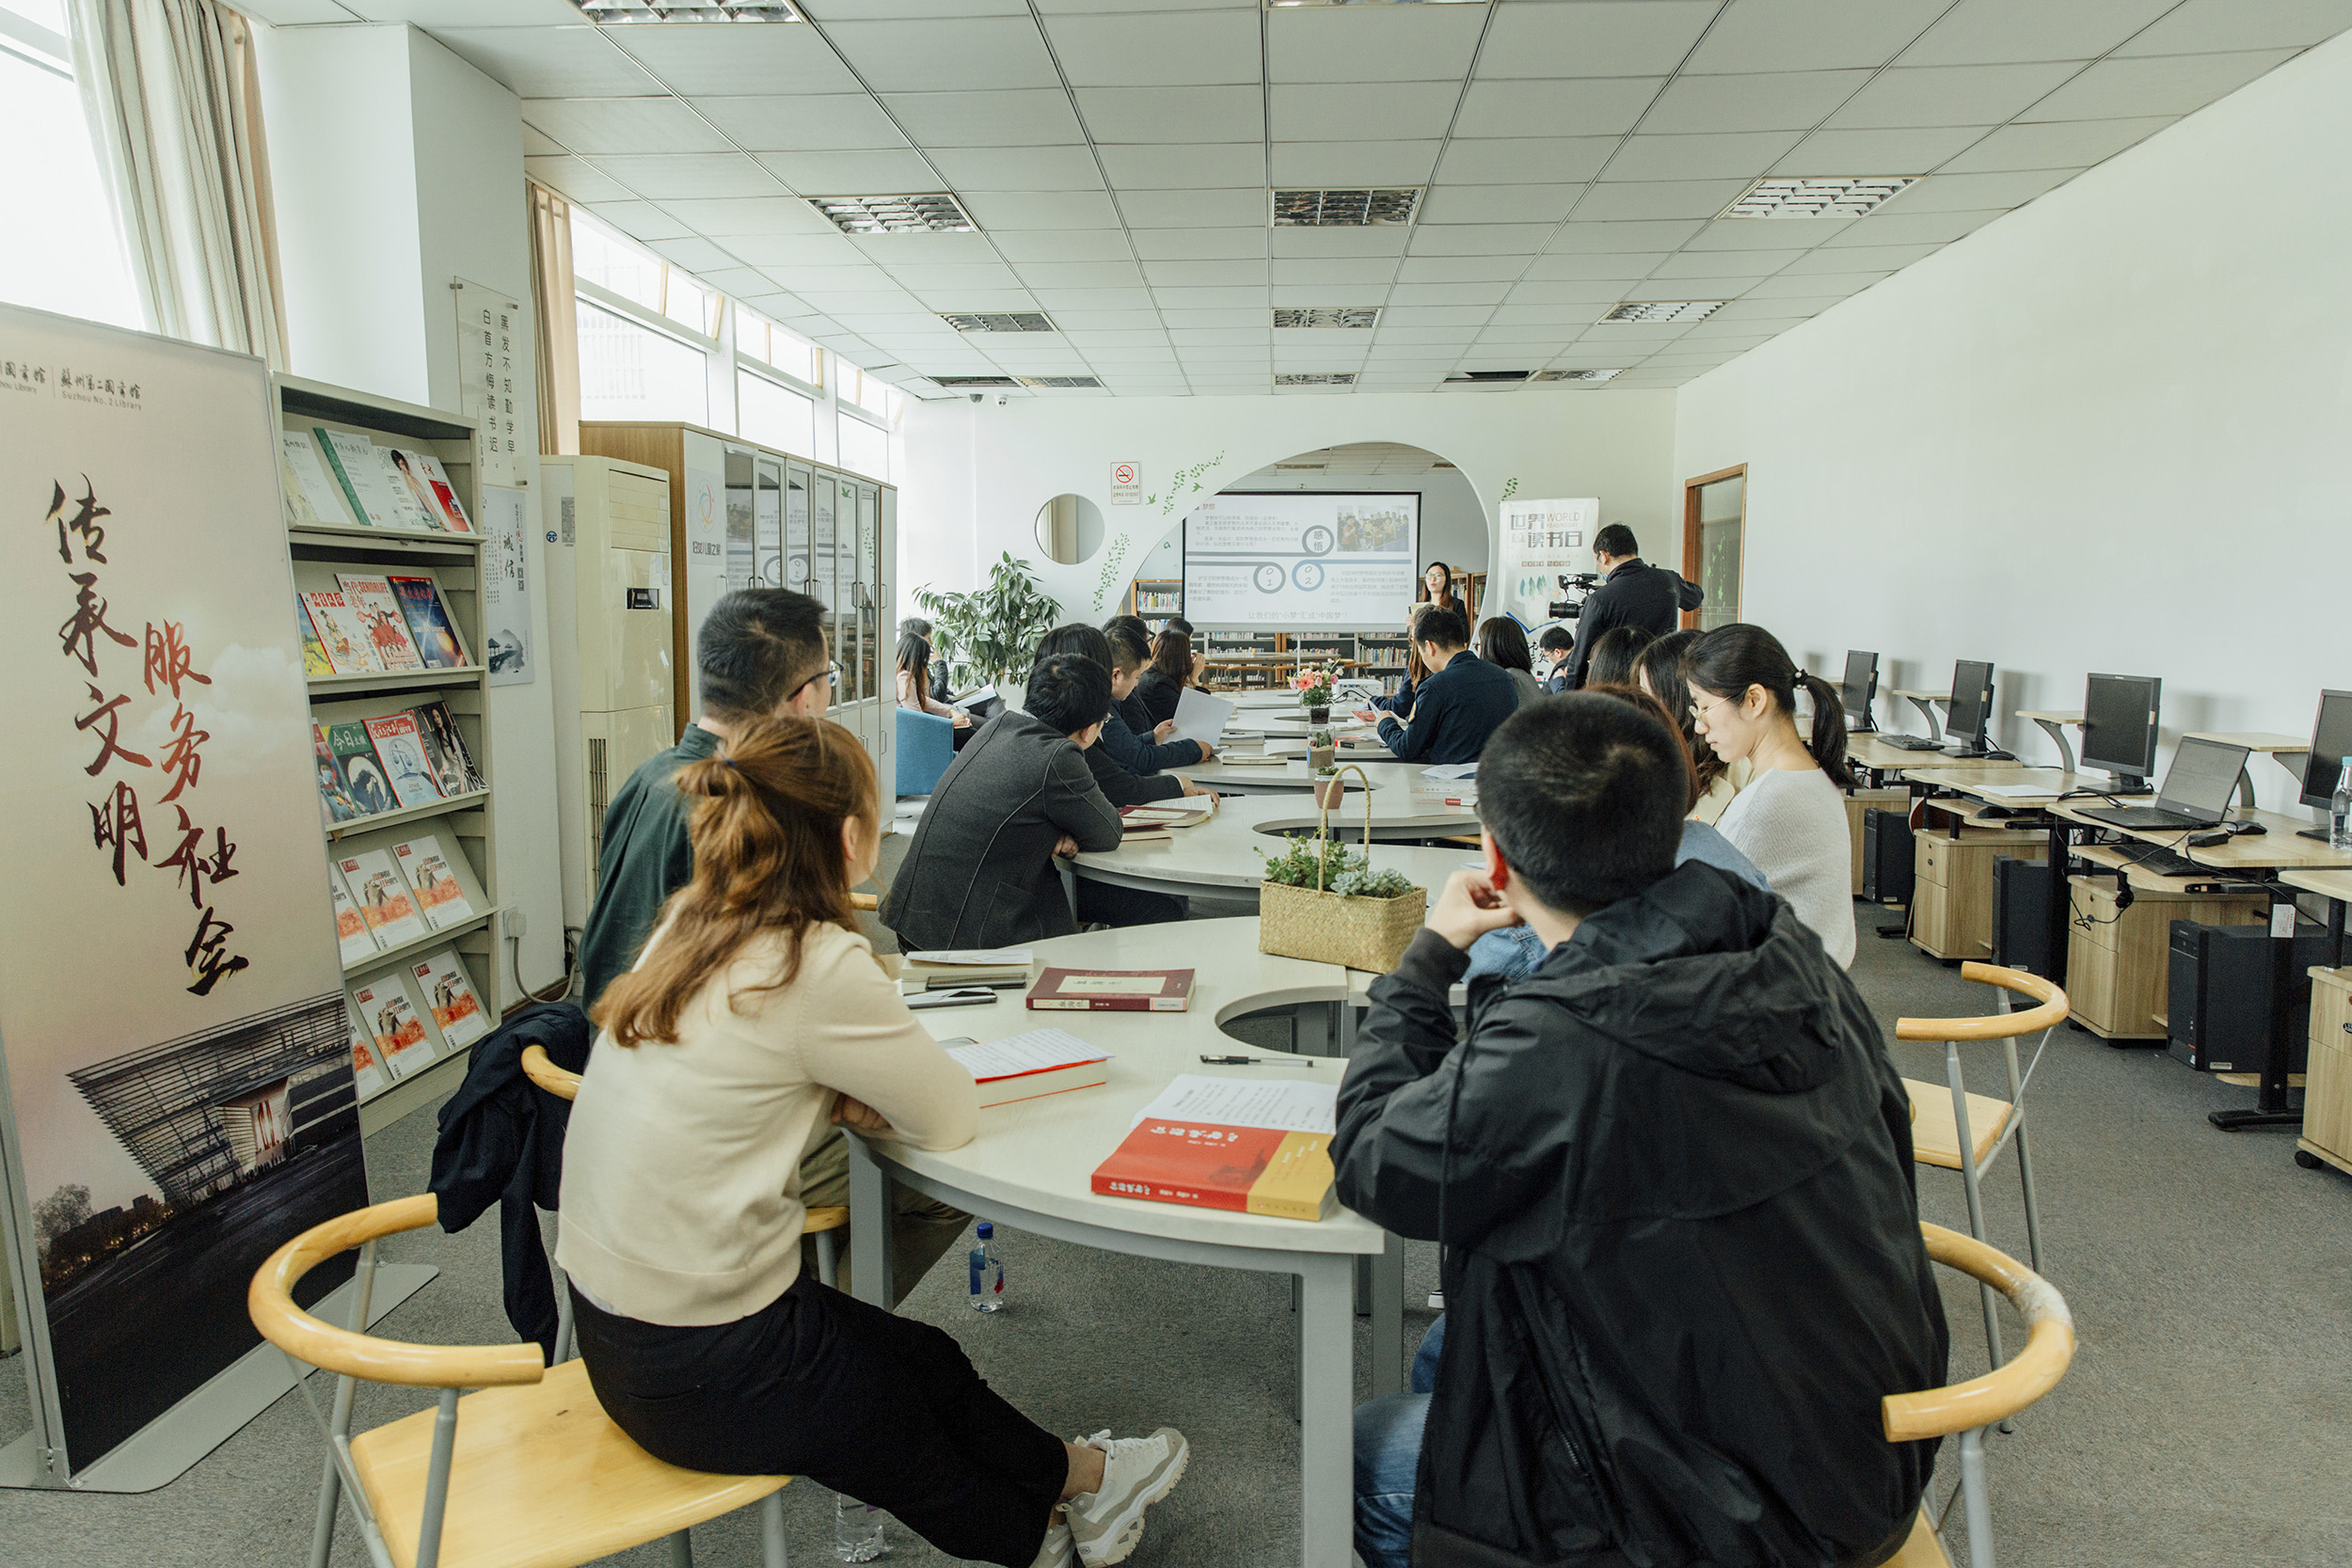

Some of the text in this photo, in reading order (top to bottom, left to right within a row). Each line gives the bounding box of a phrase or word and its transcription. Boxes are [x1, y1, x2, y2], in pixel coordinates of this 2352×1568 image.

[62, 390, 142, 411] Suzhou No. 2 Library
[1510, 514, 1545, 530] 世界
[1547, 513, 1581, 522] WORLD
[1528, 531, 1582, 548] 读书日
[44, 471, 153, 887] 传承文明
[144, 617, 249, 997] 服务社会
